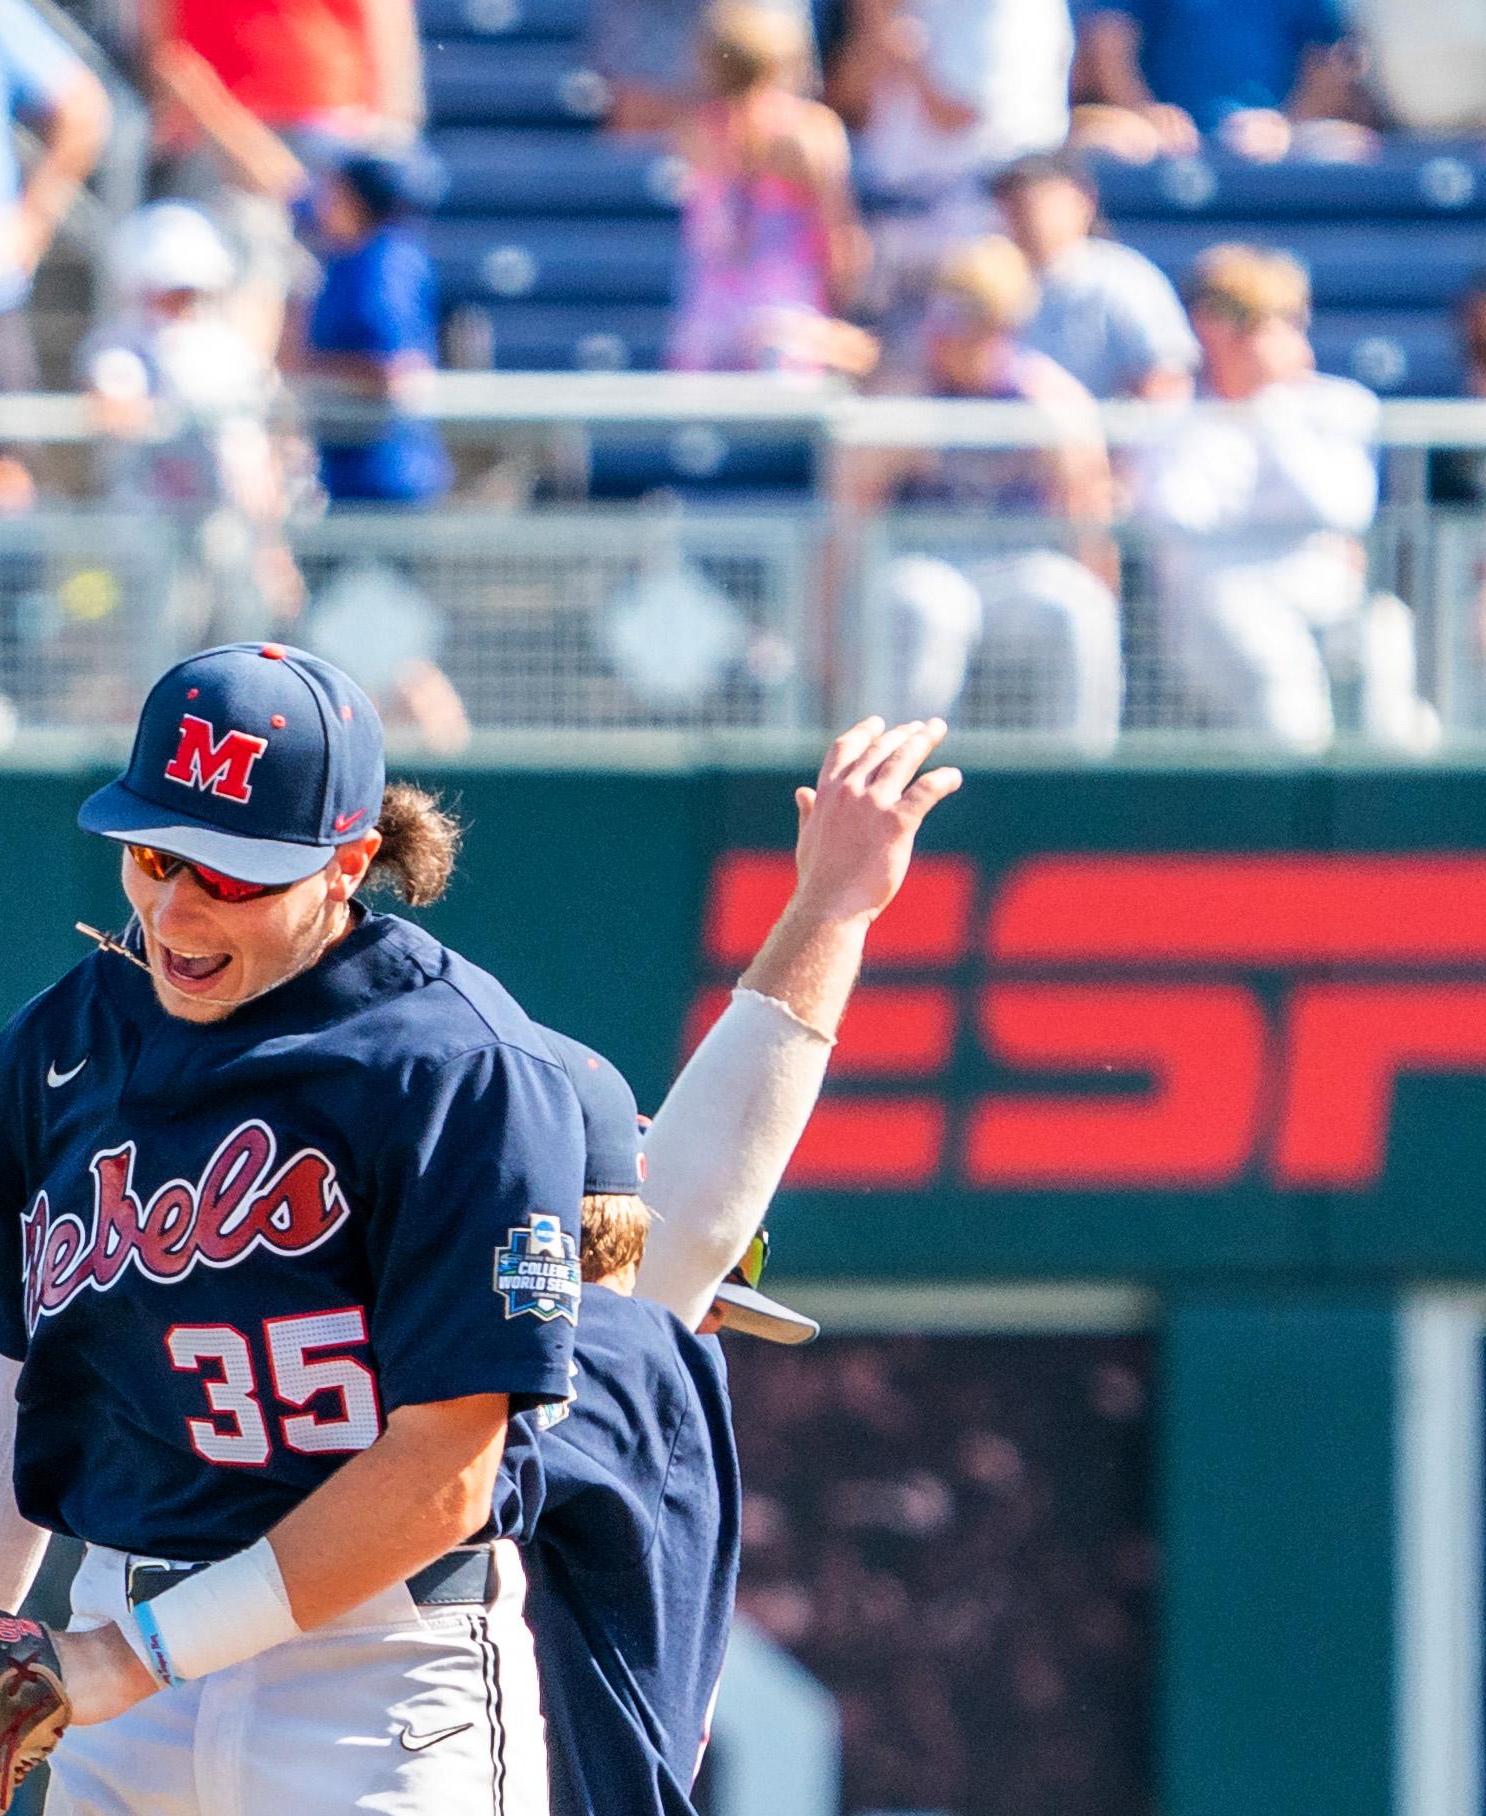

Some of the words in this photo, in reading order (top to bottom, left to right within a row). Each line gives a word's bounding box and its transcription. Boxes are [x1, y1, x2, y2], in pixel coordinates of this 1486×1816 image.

[165, 713, 268, 804] M
[669, 848, 1486, 1190] ESP
[20, 1119, 351, 1339] Rebels
[163, 1305, 384, 1468] 35
